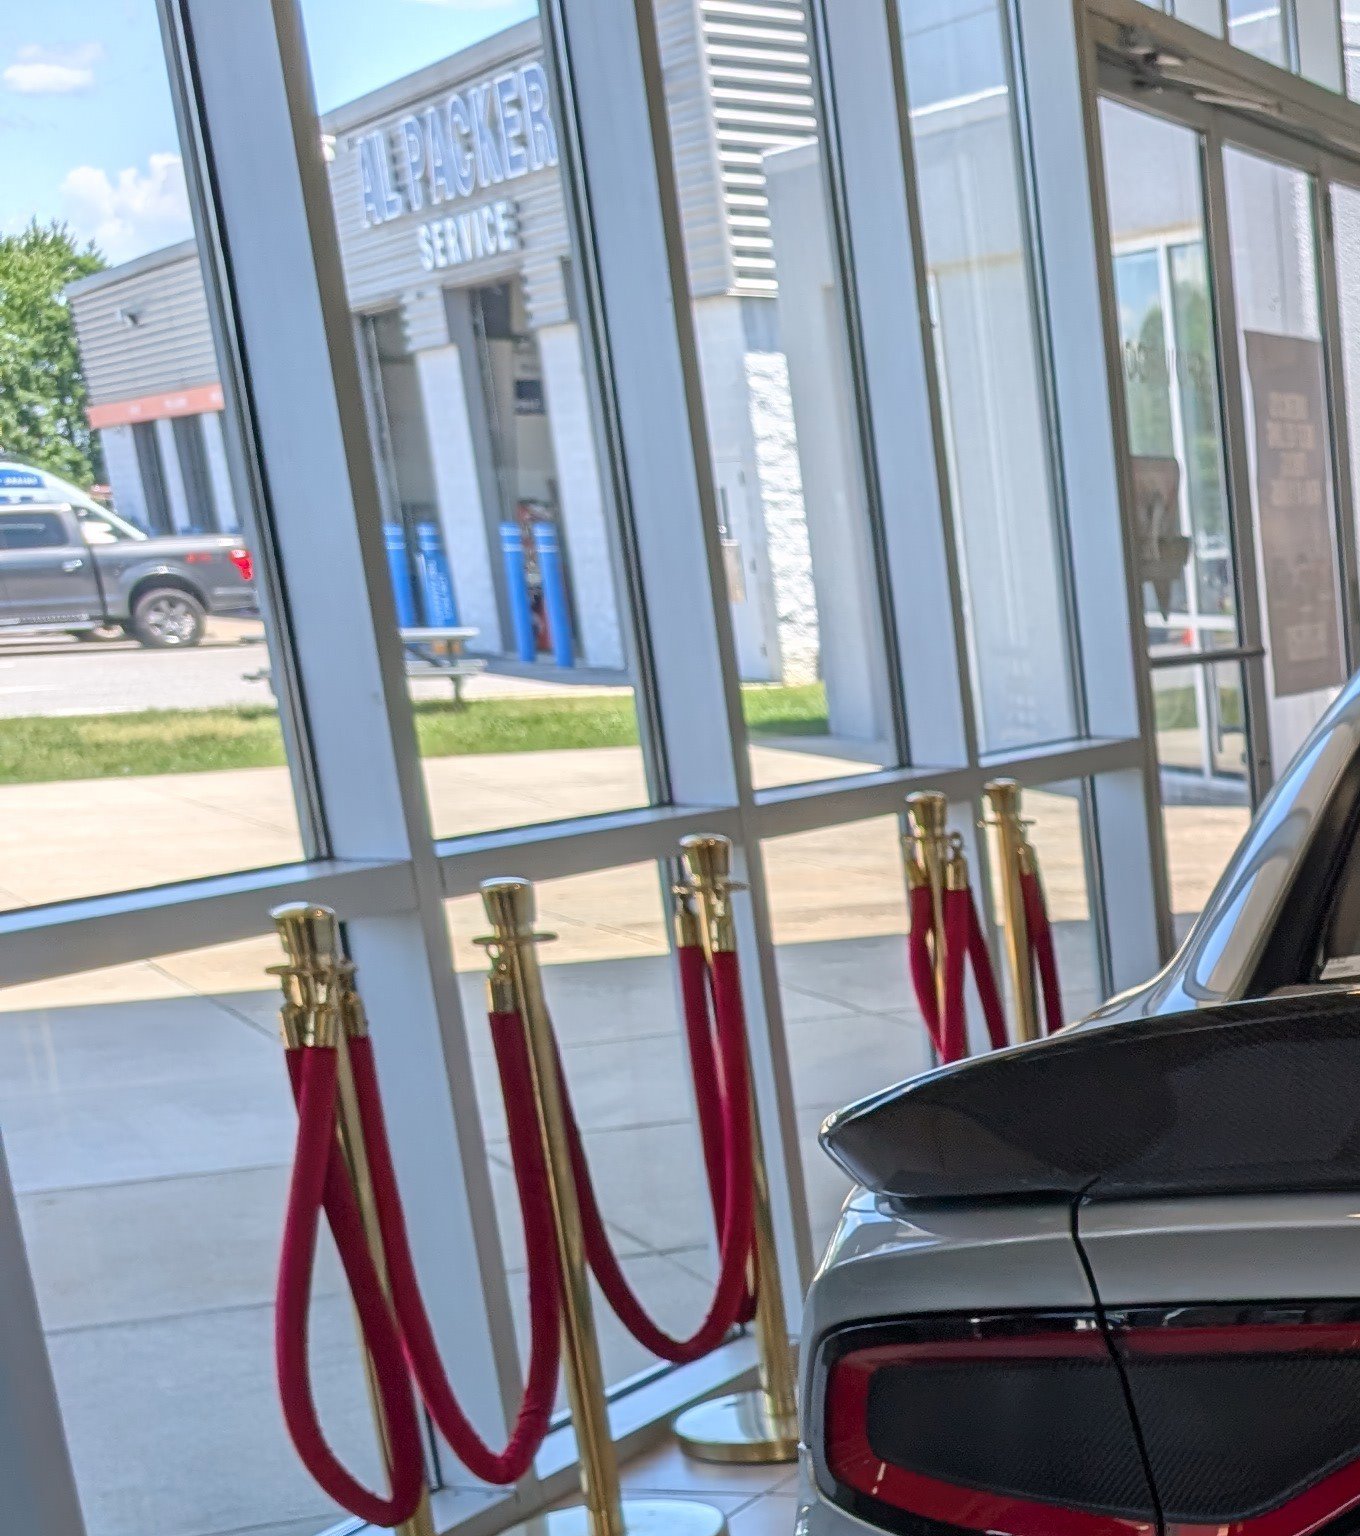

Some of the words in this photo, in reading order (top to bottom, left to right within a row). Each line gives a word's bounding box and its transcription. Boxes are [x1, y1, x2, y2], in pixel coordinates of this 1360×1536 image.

[356, 129, 404, 229] AL
[400, 61, 559, 211] PACKER
[416, 200, 514, 271] SERVICE
